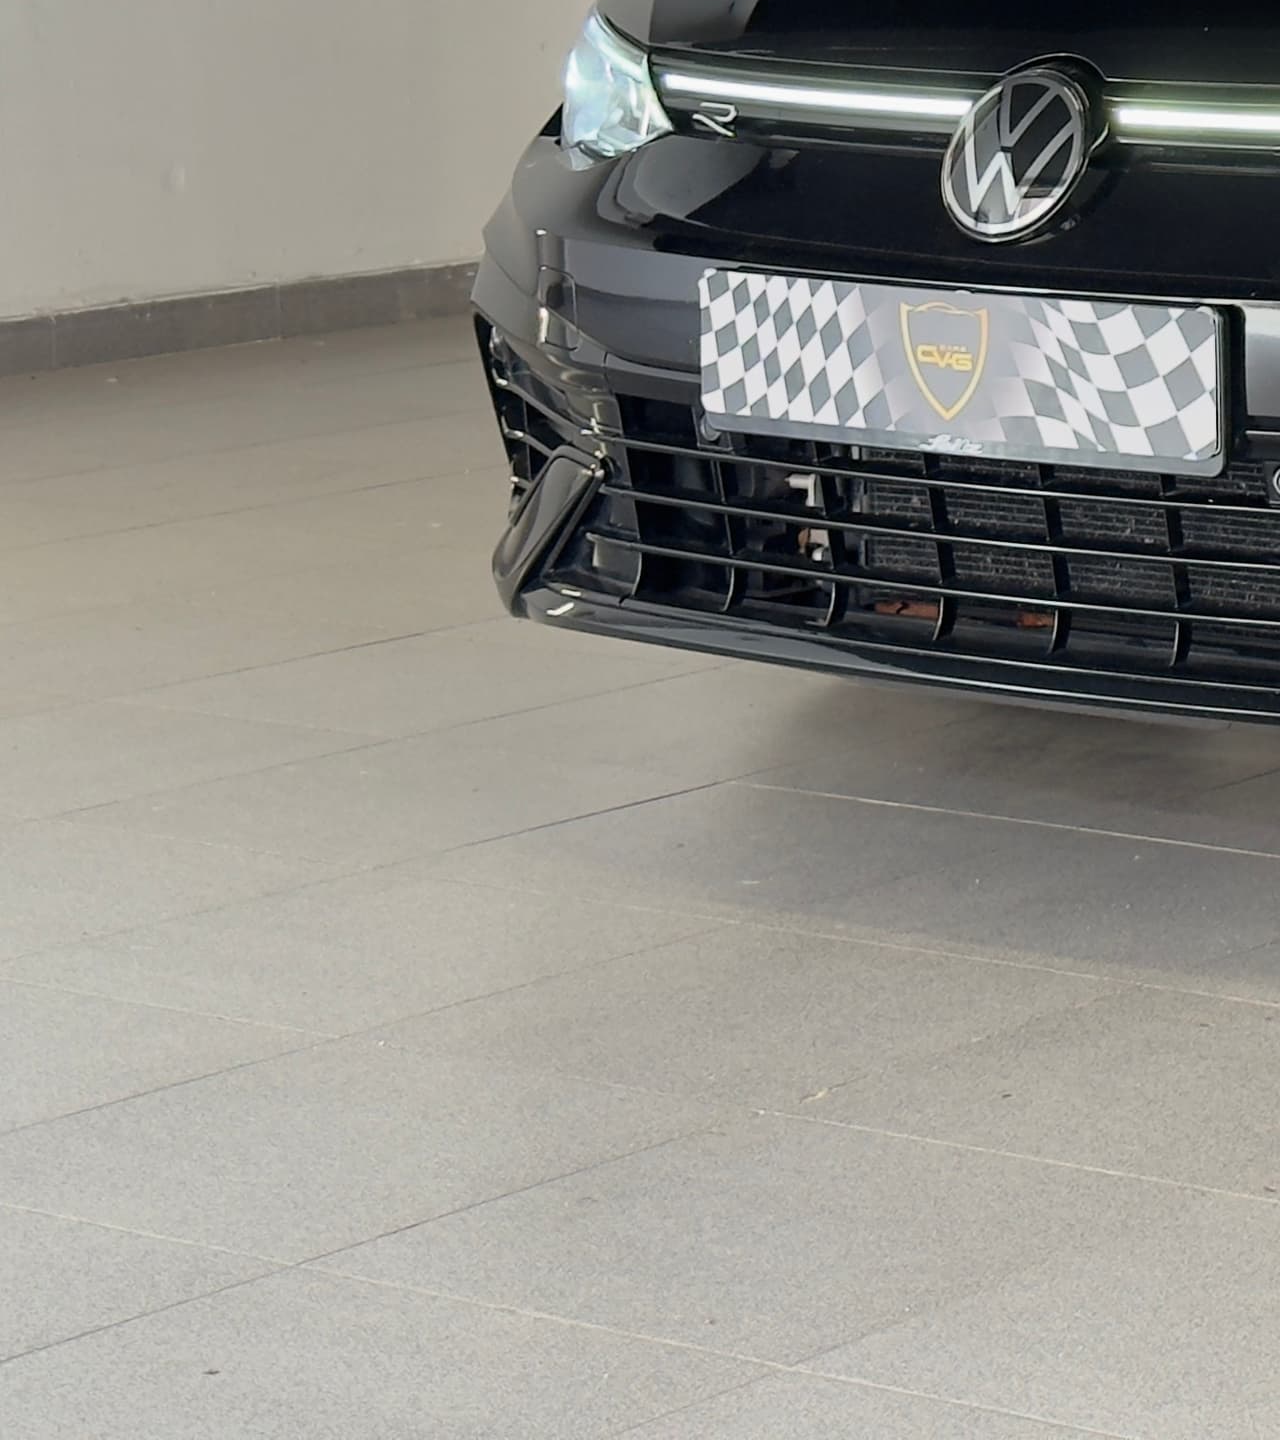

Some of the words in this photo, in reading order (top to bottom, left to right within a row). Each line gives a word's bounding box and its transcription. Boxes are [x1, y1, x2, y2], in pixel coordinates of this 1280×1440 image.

[692, 102, 737, 138] R
[946, 71, 1084, 240] VW
[916, 344, 974, 372] CVG
